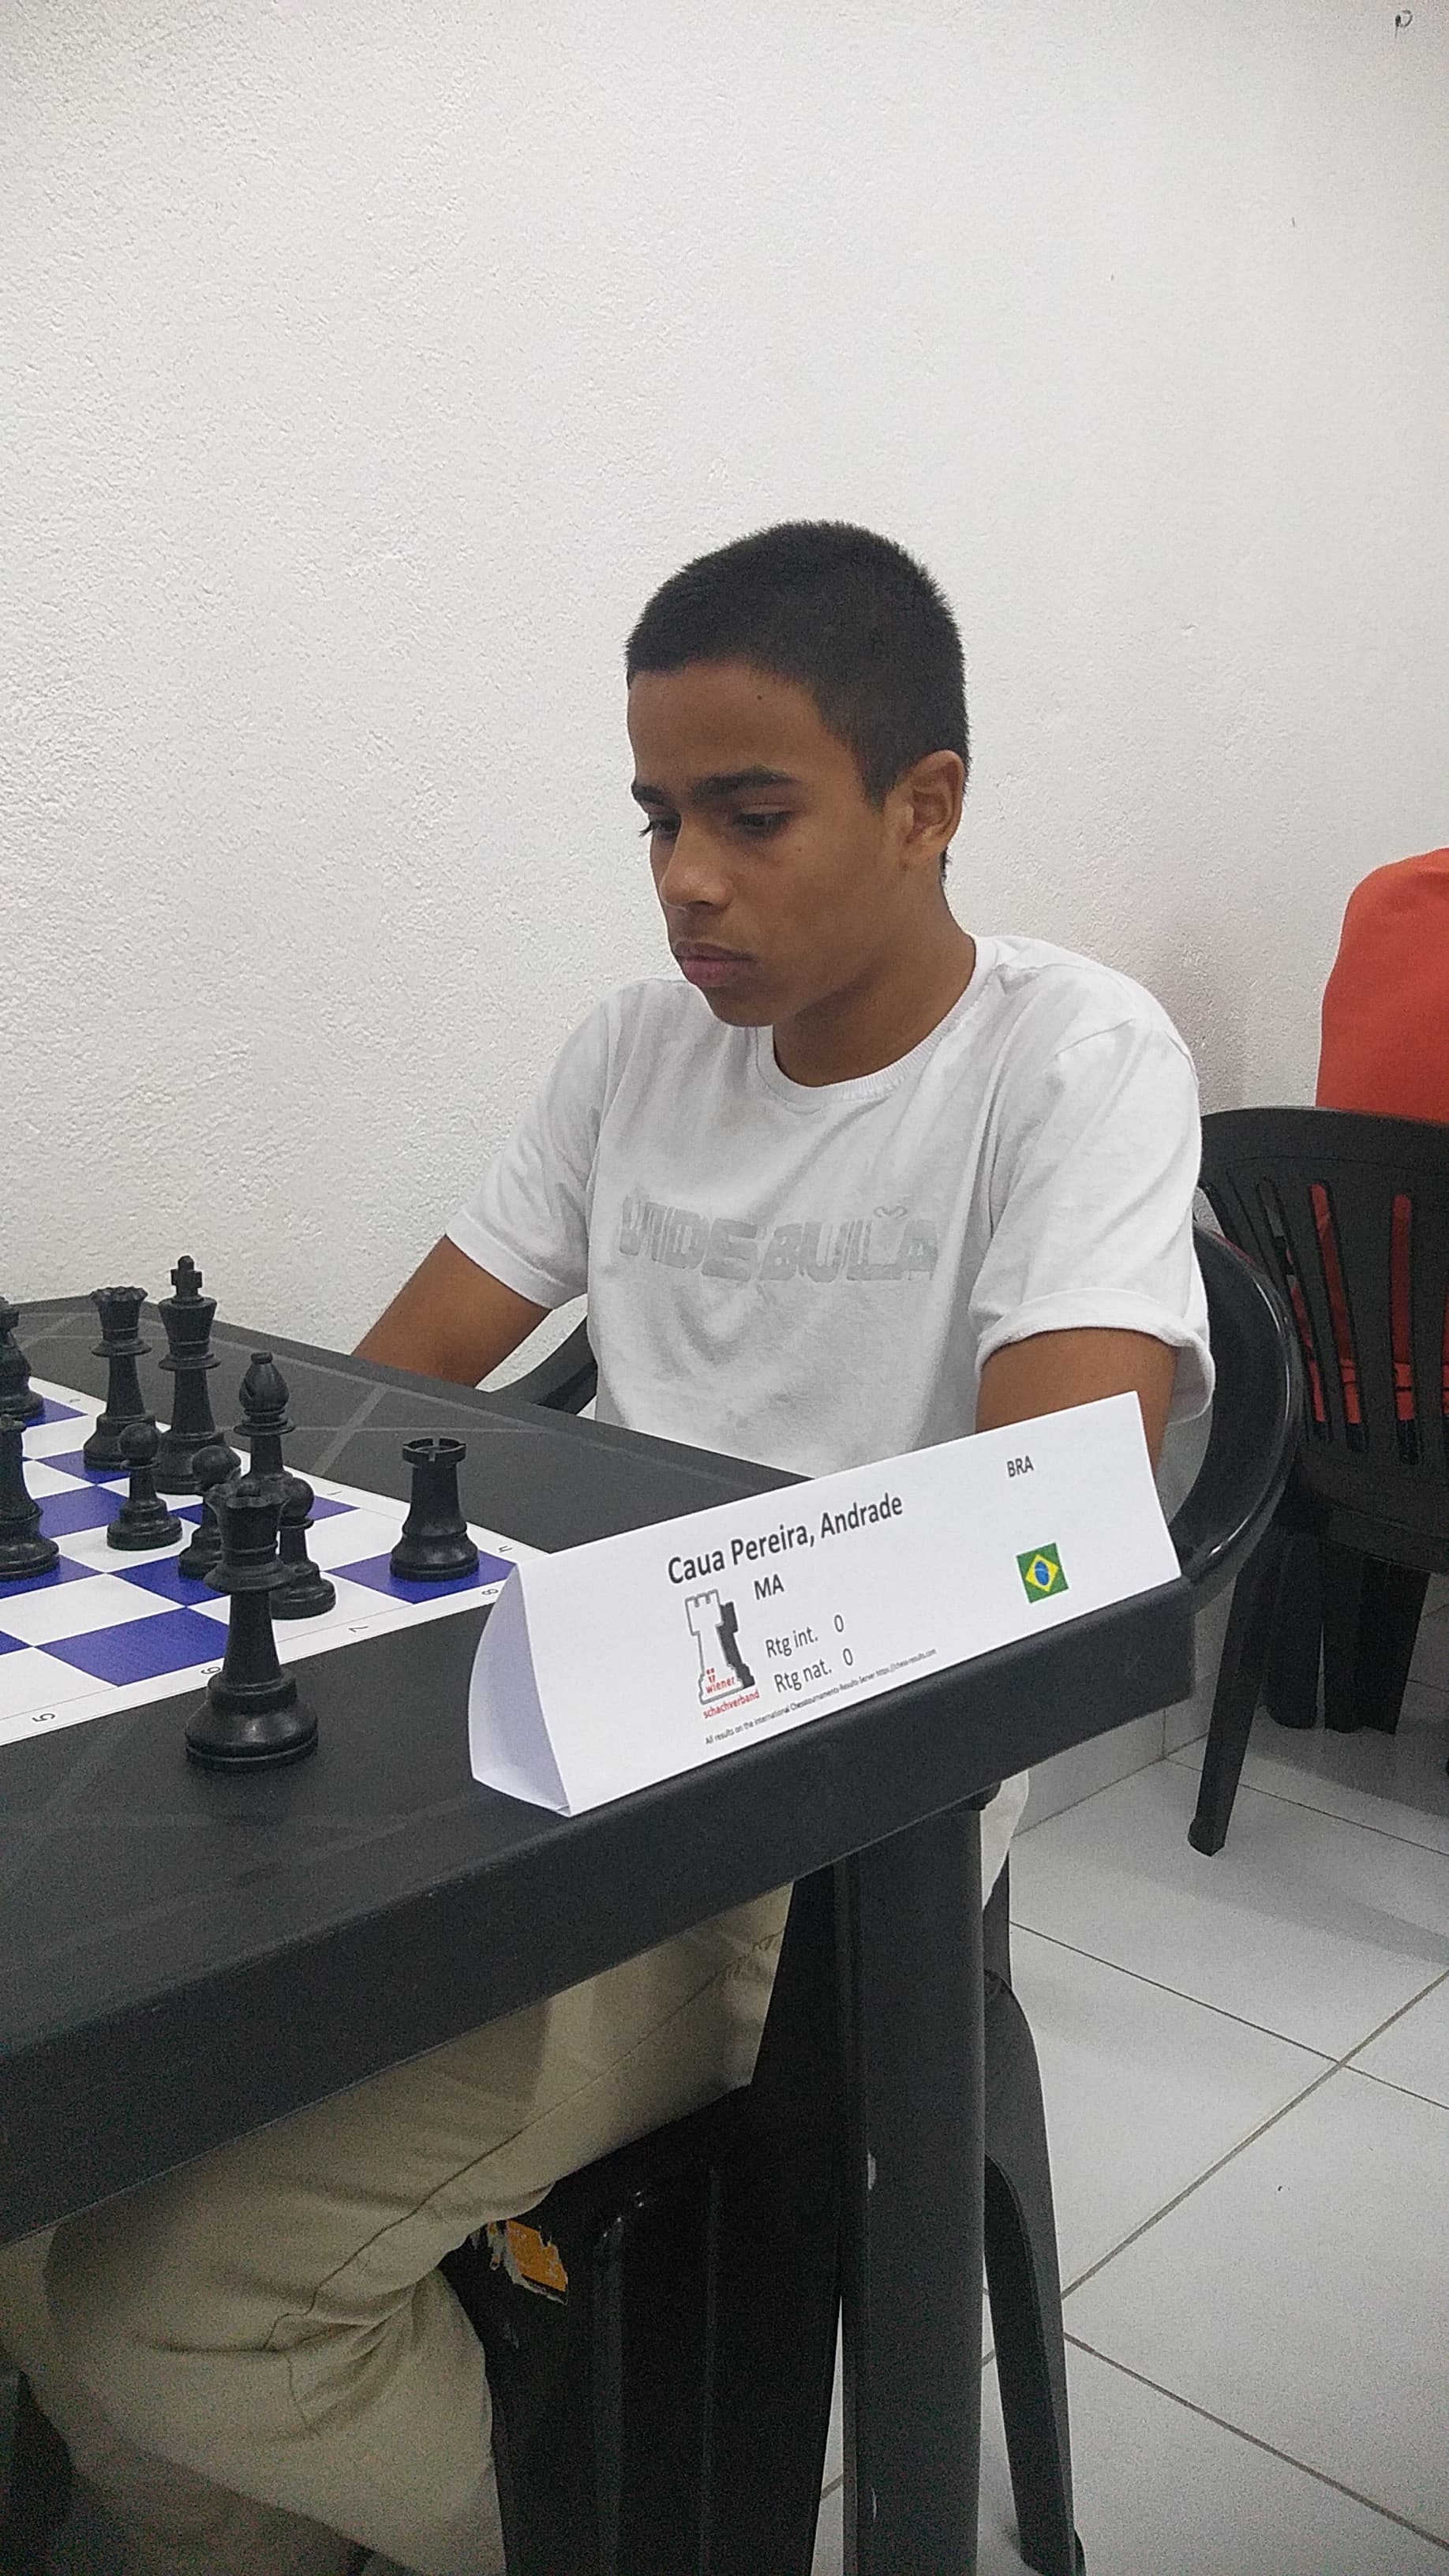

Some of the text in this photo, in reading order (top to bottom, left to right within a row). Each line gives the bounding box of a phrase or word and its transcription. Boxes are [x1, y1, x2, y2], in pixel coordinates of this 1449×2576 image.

[1006, 1455, 1035, 1478] BRA
[667, 1492, 903, 1584] Caua Pereira, Andrade
[753, 1574, 785, 1601] MA
[765, 1614, 844, 1658] Rtg int. 0
[705, 1675, 736, 1694] wiener
[773, 1647, 854, 1694] Rtg nat. 0
[702, 1688, 760, 1719] schachverband
